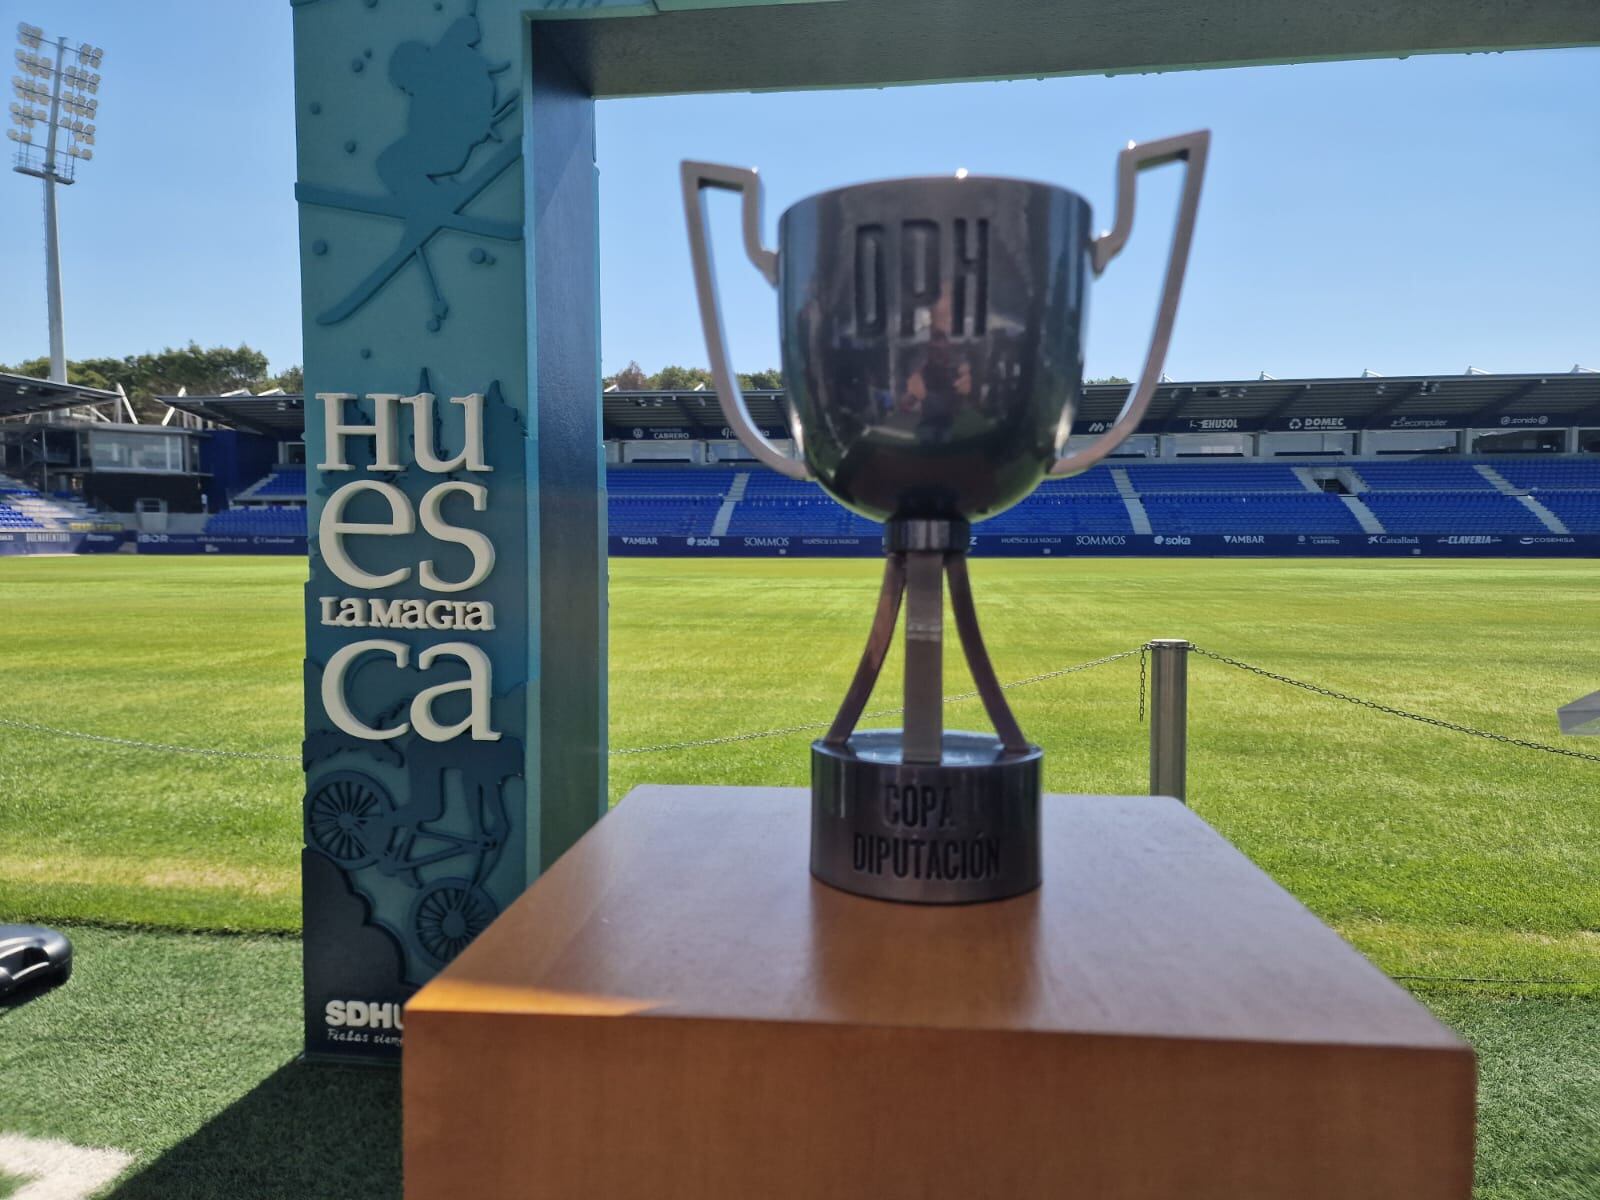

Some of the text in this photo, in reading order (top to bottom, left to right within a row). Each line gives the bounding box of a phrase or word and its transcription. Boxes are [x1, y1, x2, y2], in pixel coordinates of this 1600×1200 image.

[1304, 418, 1344, 427] DOMEC
[315, 392, 494, 473] Hu
[654, 432, 690, 440] CABRERO
[318, 479, 496, 592] es
[1076, 535, 1126, 546] SOMMOS
[1165, 536, 1191, 545] soka
[1231, 535, 1265, 545] AMBAR
[628, 537, 659, 546] AMBAR
[743, 537, 790, 547] SOMMOS
[321, 639, 502, 742] ca
[883, 783, 955, 830] COPA
[852, 830, 1002, 882] DIPUTACIÓN
